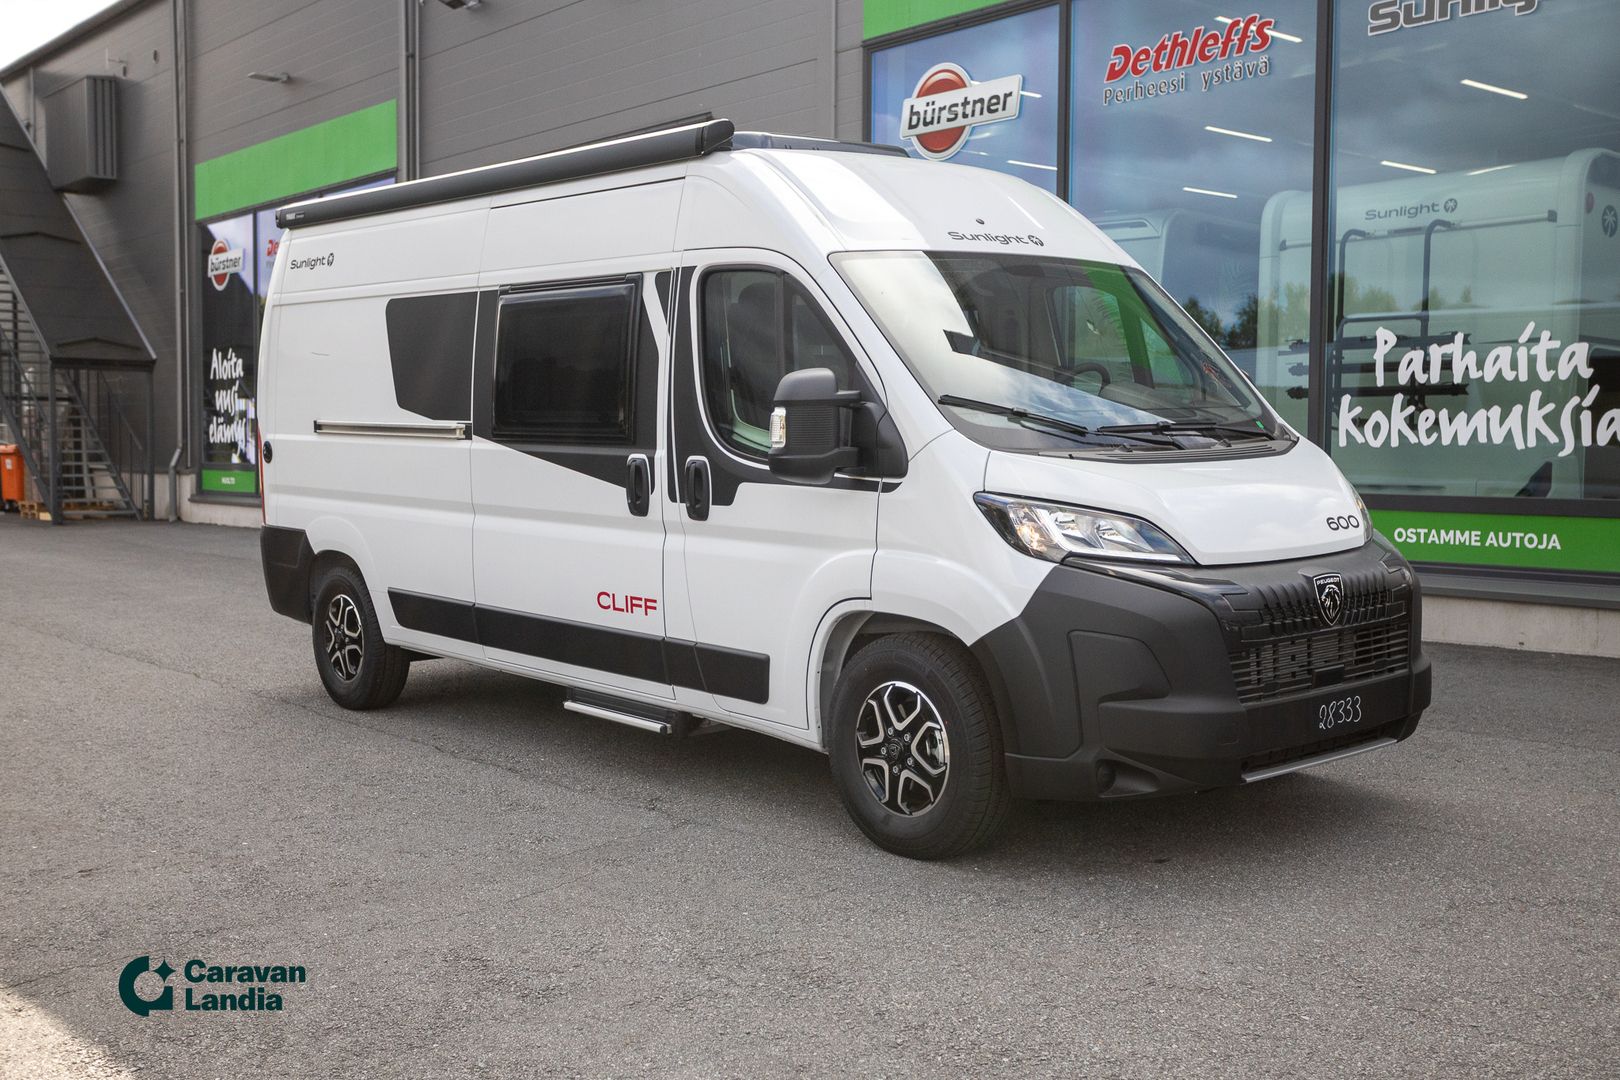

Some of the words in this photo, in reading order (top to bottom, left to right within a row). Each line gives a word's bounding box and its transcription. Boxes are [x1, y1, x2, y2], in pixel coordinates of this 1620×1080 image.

[1104, 13, 1274, 83] Dethleffs
[1103, 72, 1185, 105] Perheesi
[1201, 56, 1271, 92] ystävä
[907, 90, 1013, 131] bürstner
[1364, 202, 1441, 221] Sunlight
[947, 231, 1030, 246] Sunlight
[210, 256, 241, 273] bürstner
[290, 256, 326, 271] Sunlight
[210, 347, 244, 381] Aloita
[1373, 321, 1594, 387] Parhaita
[1326, 514, 1360, 532] 600
[1393, 527, 1481, 547] OSTAMME
[1485, 531, 1561, 550] AUTOJA
[1316, 577, 1340, 585] PEUGEOT
[596, 591, 657, 616] CLIFF
[1318, 695, 1362, 730] 28333
